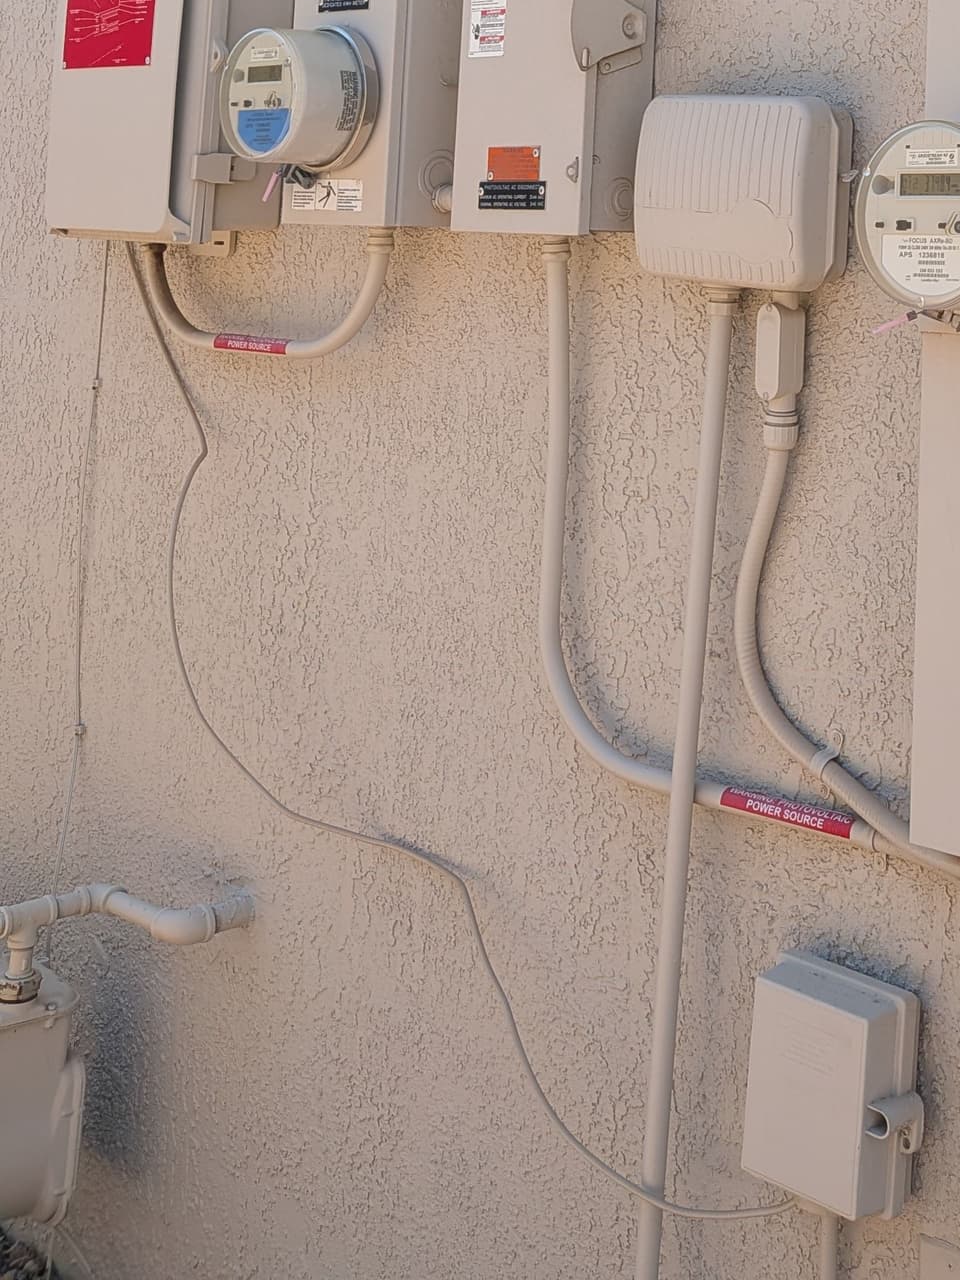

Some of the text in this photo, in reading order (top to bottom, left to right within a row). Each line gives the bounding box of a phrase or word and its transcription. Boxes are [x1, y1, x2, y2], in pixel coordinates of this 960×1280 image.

[227, 340, 272, 351] POWER SOURCE
[746, 799, 825, 829] POWER SOURCE
[778, 798, 851, 824] PHOTOVOLTAIC
